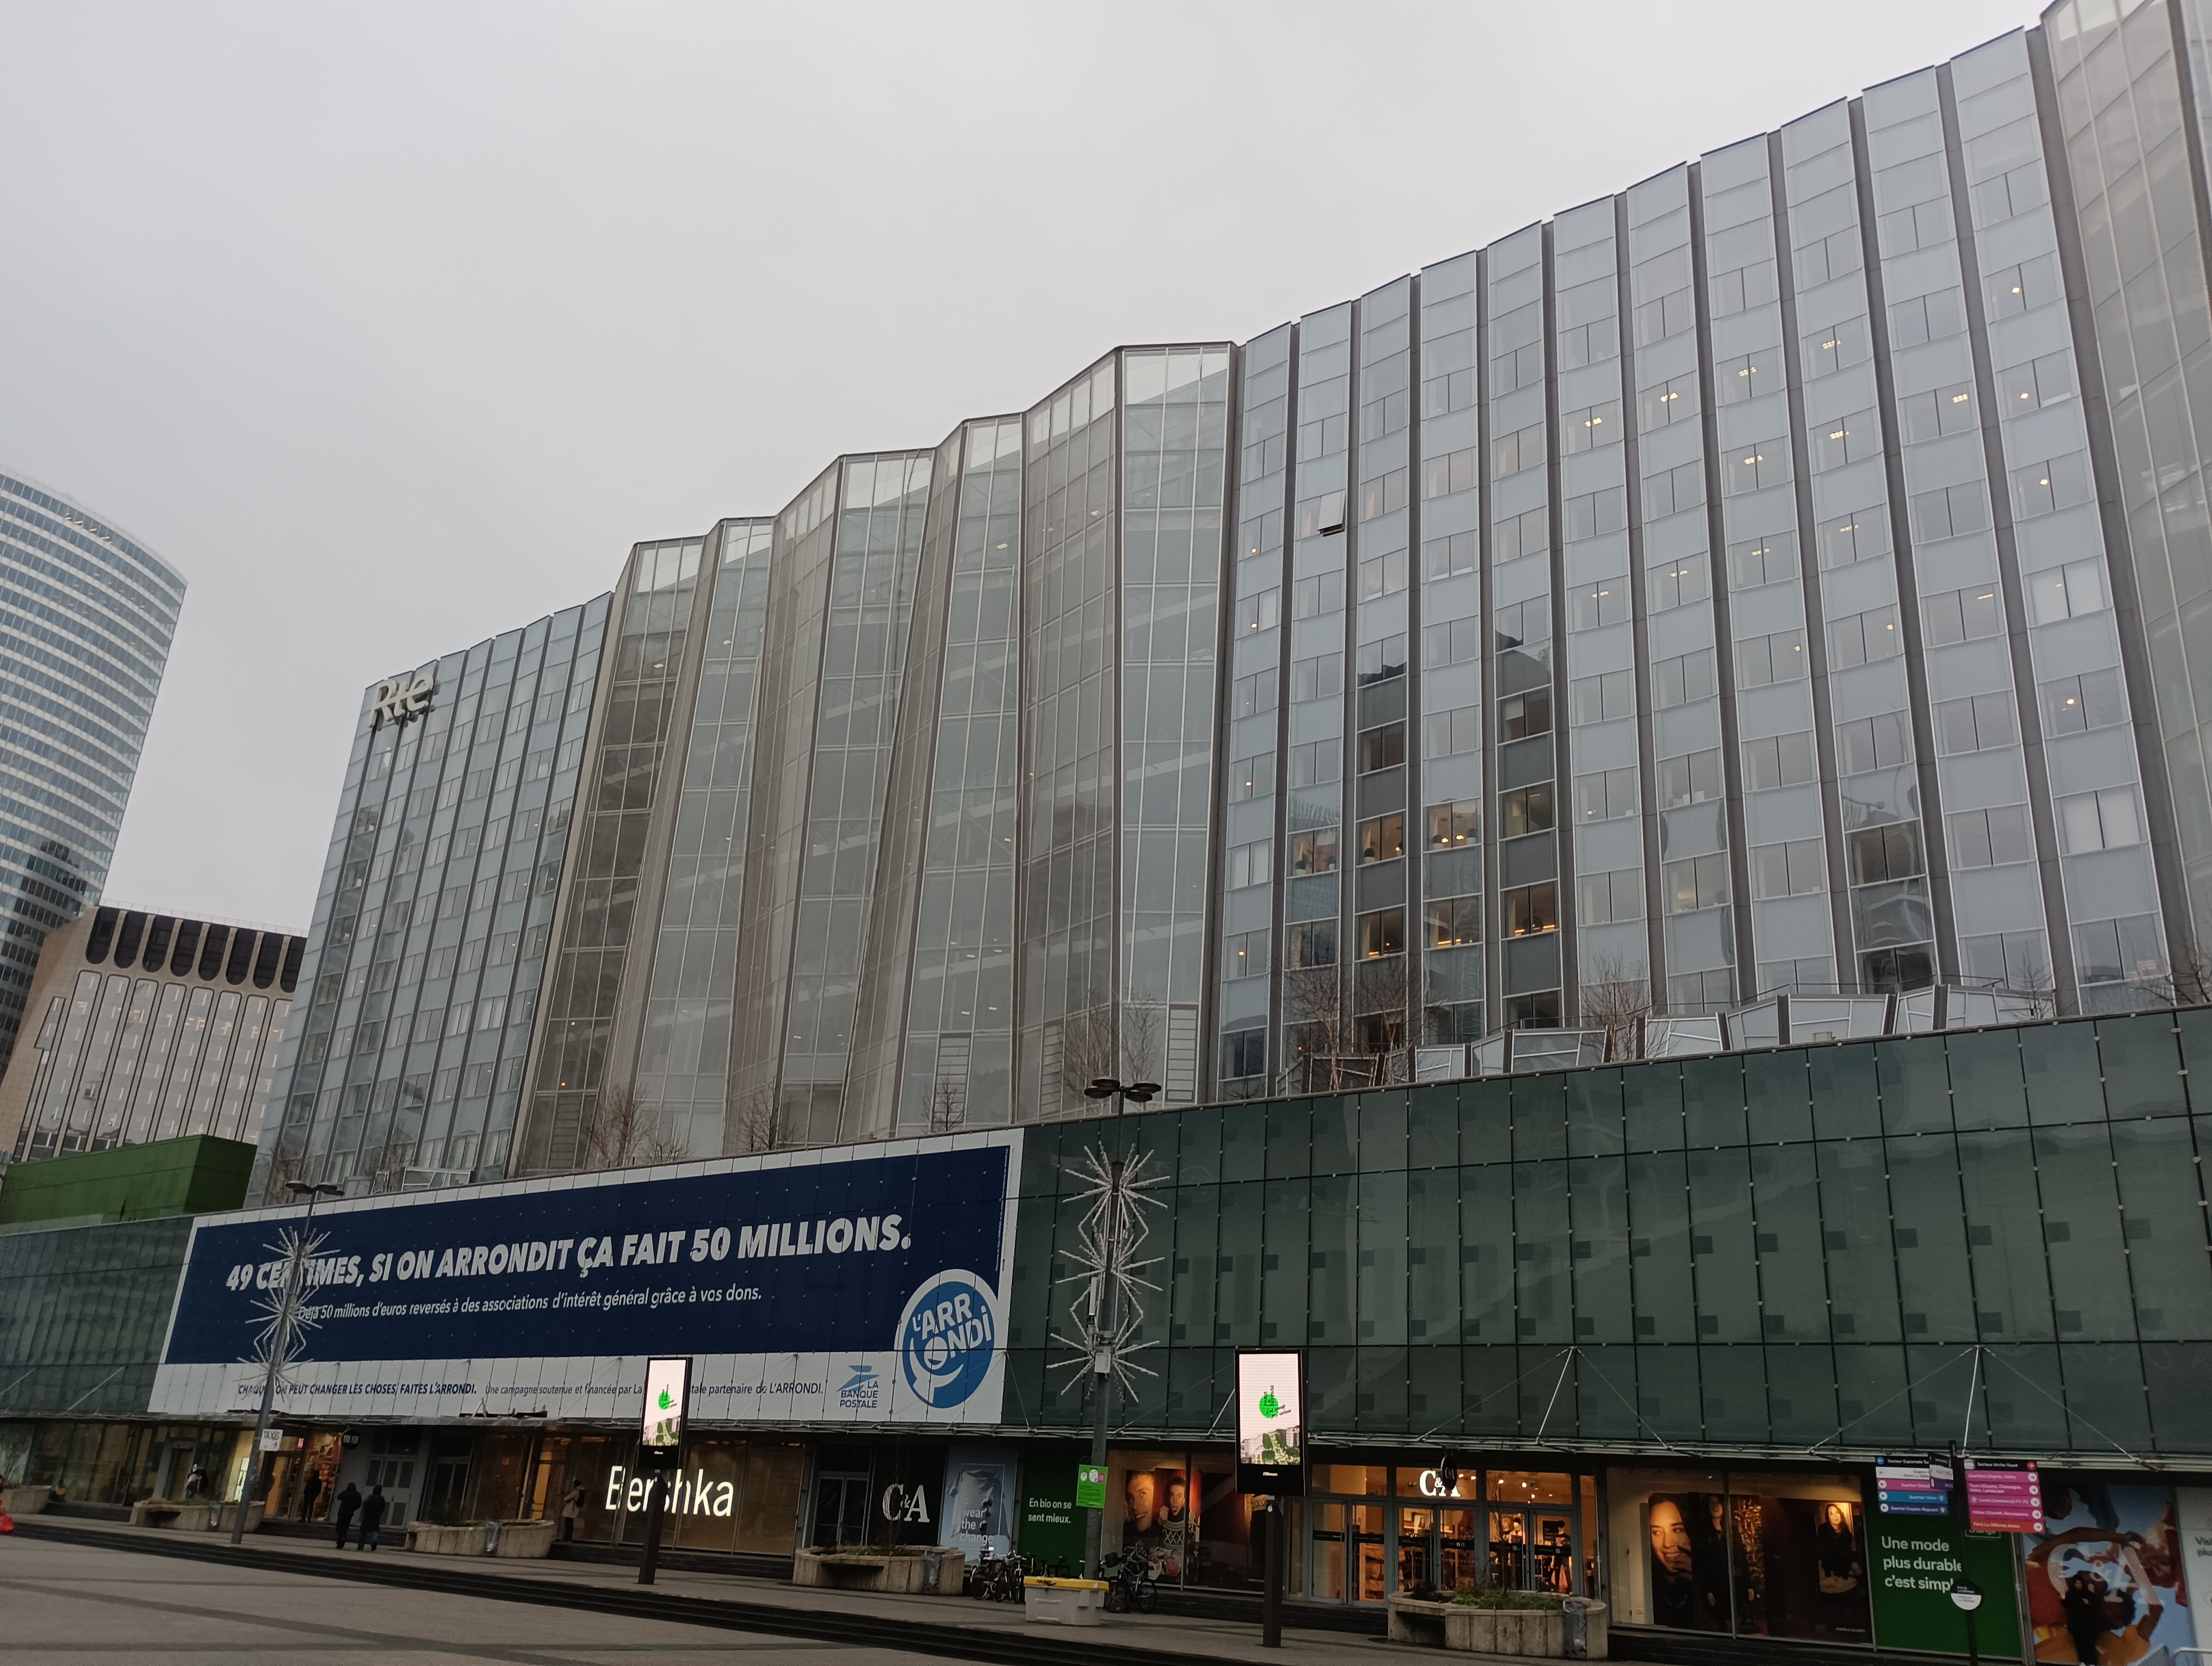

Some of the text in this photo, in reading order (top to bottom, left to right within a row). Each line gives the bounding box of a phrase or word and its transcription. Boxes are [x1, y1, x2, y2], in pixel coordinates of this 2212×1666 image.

[226, 1264, 254, 1291] 49
[369, 1253, 394, 1282] SI
[397, 1250, 434, 1280] ON
[435, 1239, 574, 1278] ARRONDIT
[577, 1236, 614, 1278] ÇA
[620, 1231, 686, 1266] FAIT
[690, 1227, 731, 1262] 50
[738, 1214, 911, 1258] MILLIONS.
[320, 1304, 334, 1319] 50
[333, 1302, 370, 1318] millions
[372, 1301, 407, 1317] d'euros
[409, 1298, 451, 1315] reversés
[452, 1297, 459, 1313] à
[461, 1296, 480, 1313] des
[482, 1294, 549, 1311] associations
[552, 1291, 602, 1308] d'intérêt
[603, 1287, 650, 1311] général
[651, 1287, 686, 1309] grâce
[689, 1285, 697, 1302] à
[700, 1289, 723, 1302] vos
[726, 1283, 762, 1301] dons.
[289, 1384, 308, 1394] PEUT
[310, 1384, 348, 1395] CHANGER
[349, 1383, 363, 1394] LES
[365, 1383, 397, 1396] CHOSES,
[400, 1383, 428, 1394] FAITES
[429, 1381, 477, 1394] L'ARRONDI.
[486, 1385, 499, 1394] Une
[500, 1386, 537, 1397] campagne
[539, 1385, 573, 1394] soutenue
[575, 1385, 583, 1394] et
[585, 1383, 616, 1394] financée
[618, 1386, 632, 1397] par
[634, 1383, 642, 1394] La
[708, 1383, 753, 1397] partenaire
[769, 1382, 824, 1394] L'ARRONDI.
[867, 1381, 879, 1389] LA
[841, 1390, 879, 1399] BANQUE
[839, 1400, 877, 1408] POSTALE
[263, 1431, 280, 1440] TAXIS
[882, 1483, 930, 1523] C&A
[1029, 1498, 1039, 1508] En
[1040, 1498, 1051, 1508] bio
[962, 1508, 985, 1518] wear
[1028, 1513, 1071, 1523] sent mieux.
[961, 1518, 976, 1530] the
[960, 1530, 994, 1546] change
[1881, 1536, 1950, 1552] Une mode
[1883, 1555, 1911, 1571] plus
[1885, 1574, 1916, 1589] c'est
